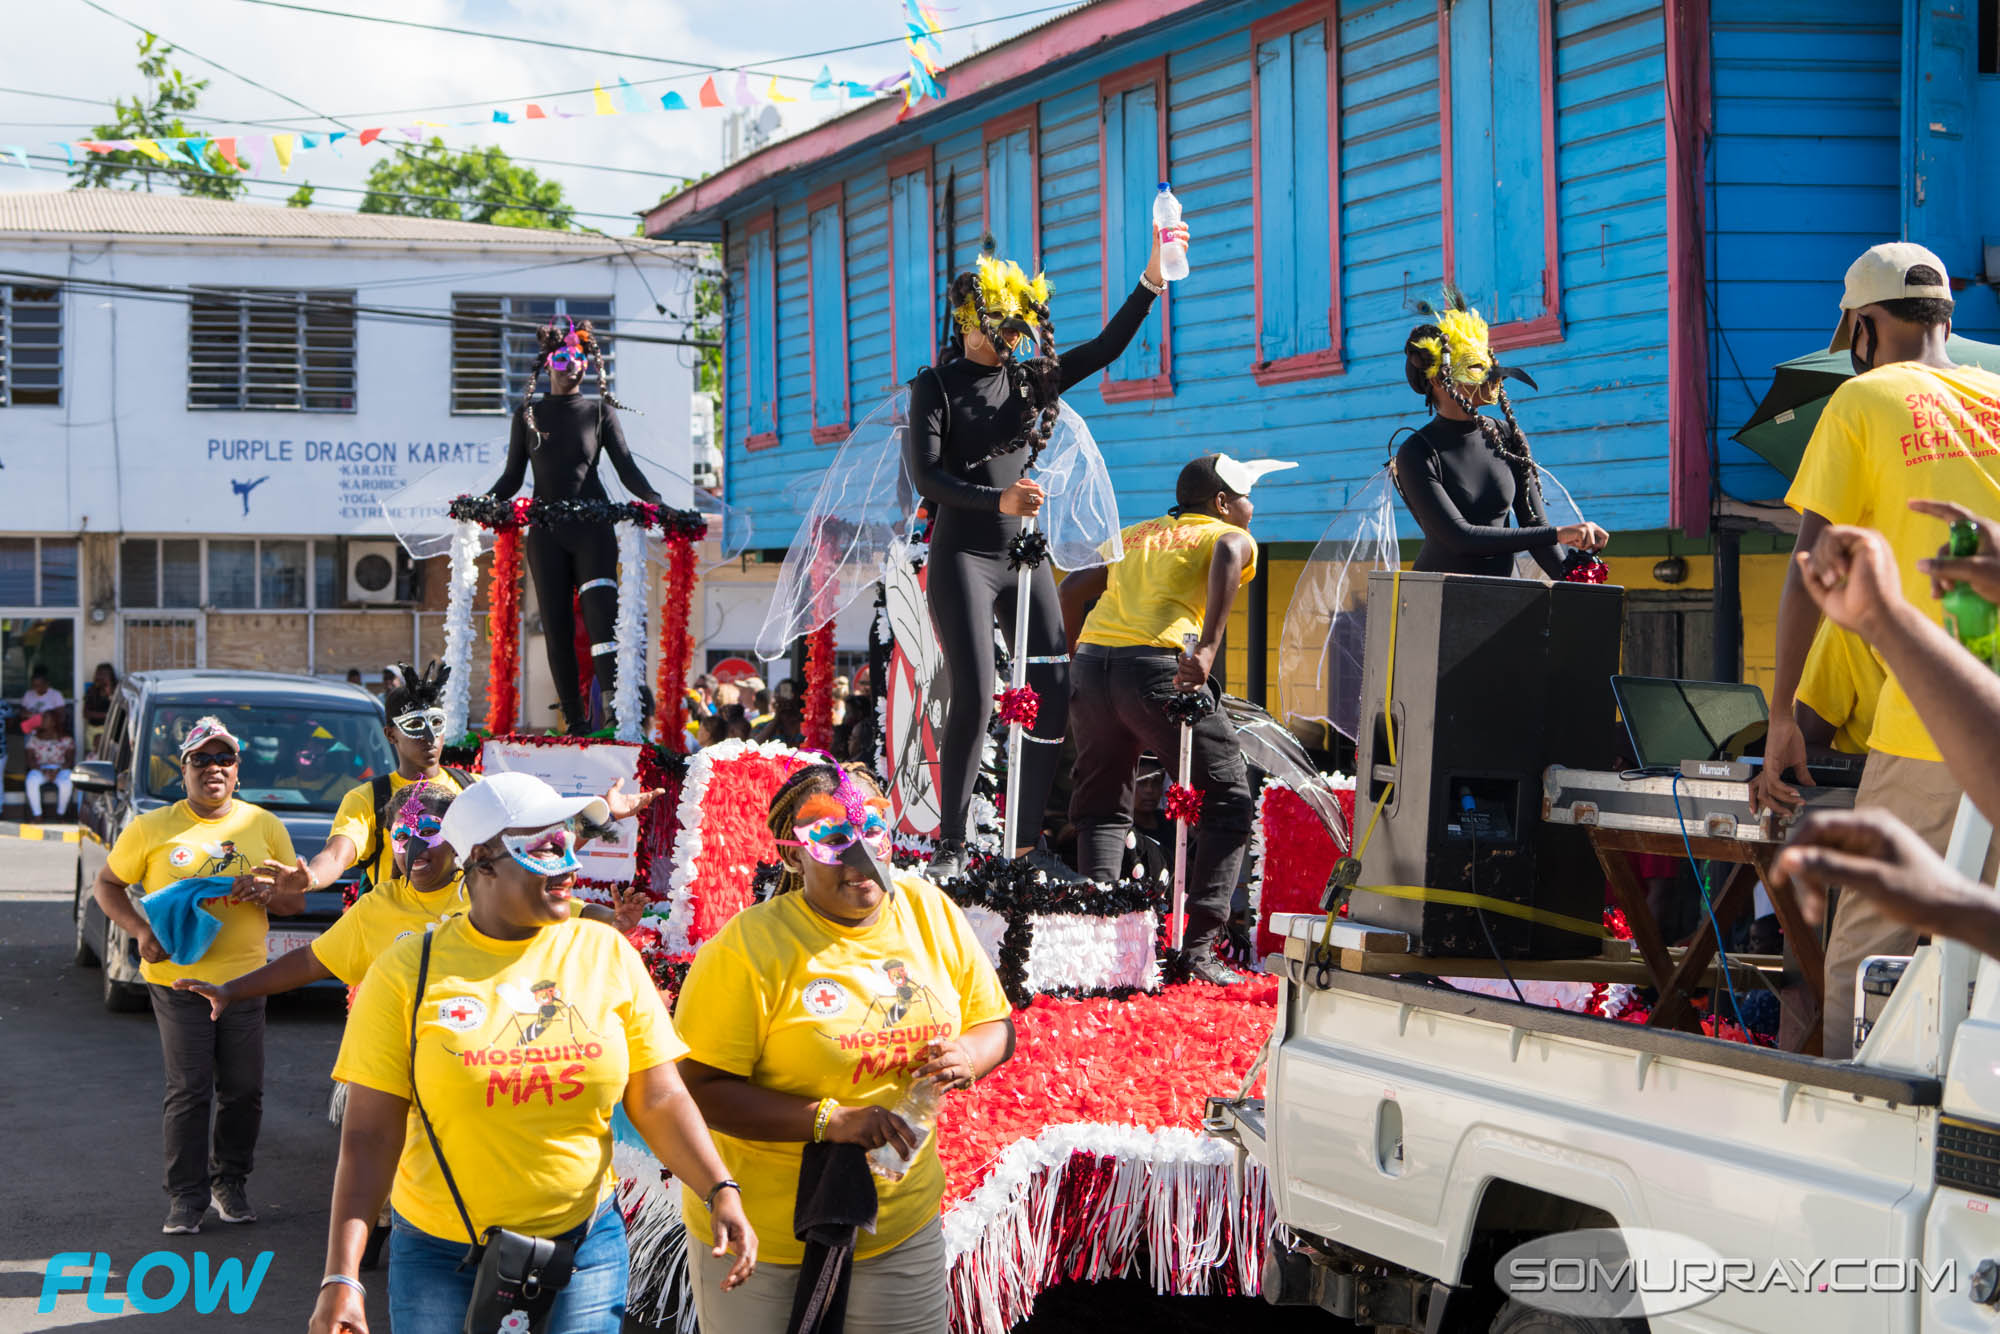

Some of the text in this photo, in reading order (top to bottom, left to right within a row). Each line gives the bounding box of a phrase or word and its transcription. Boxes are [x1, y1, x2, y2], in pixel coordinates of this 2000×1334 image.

[1912, 411, 1949, 429] BIG
[208, 439, 293, 462] PURPLE
[305, 441, 397, 463] DRAGON
[408, 443, 491, 464] KARATE
[1900, 429, 1959, 457] FIGHT
[341, 464, 398, 476] KARATE
[1905, 452, 1944, 467] DESTROY
[1699, 763, 1730, 777] Numark
[839, 1022, 952, 1050] MOSQUITO
[463, 1042, 603, 1067] MOSQUITO
[486, 1064, 587, 1107] MAS
